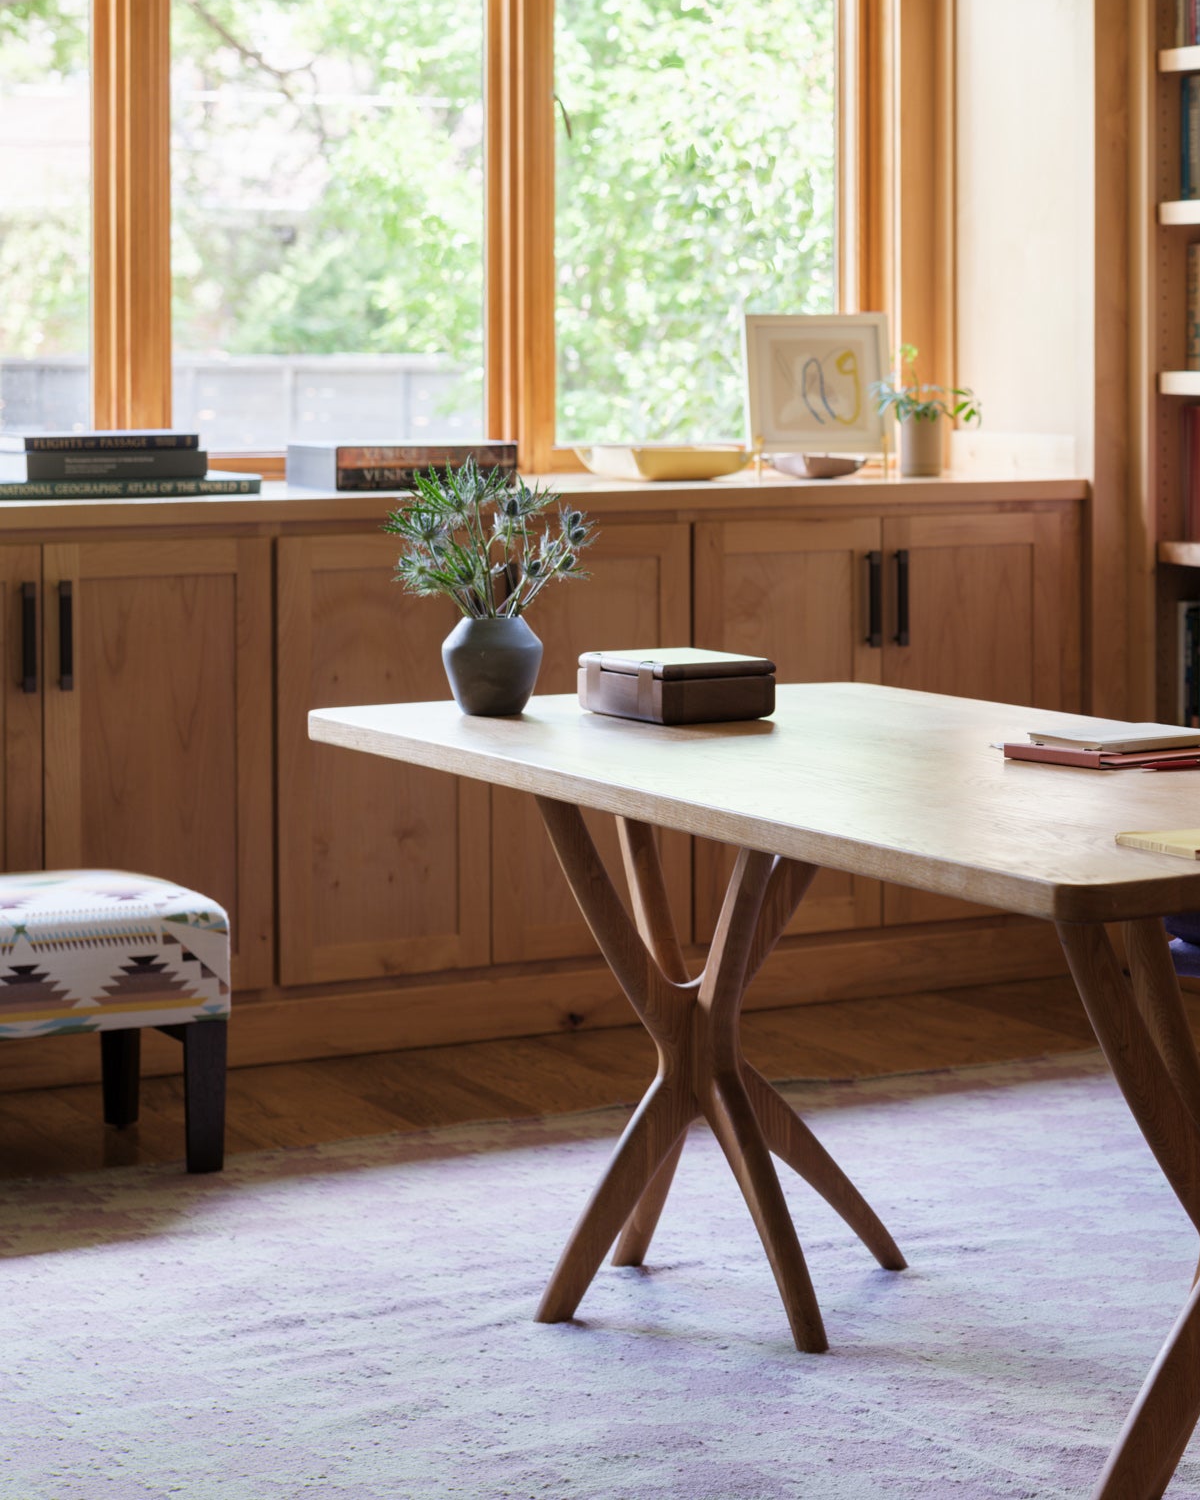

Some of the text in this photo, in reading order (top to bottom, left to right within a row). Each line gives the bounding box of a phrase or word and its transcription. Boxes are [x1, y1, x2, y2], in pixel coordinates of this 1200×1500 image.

[33, 438, 84, 450] FLIGHTS
[100, 436, 147, 449] PASSAGE
[363, 468, 417, 481] VENIC
[55, 483, 122, 495] GEOGRAPHIC
[126, 482, 158, 494] ATLAS
[160, 481, 173, 493] OF
[176, 481, 198, 493] THE
[200, 480, 238, 492] WORLD
